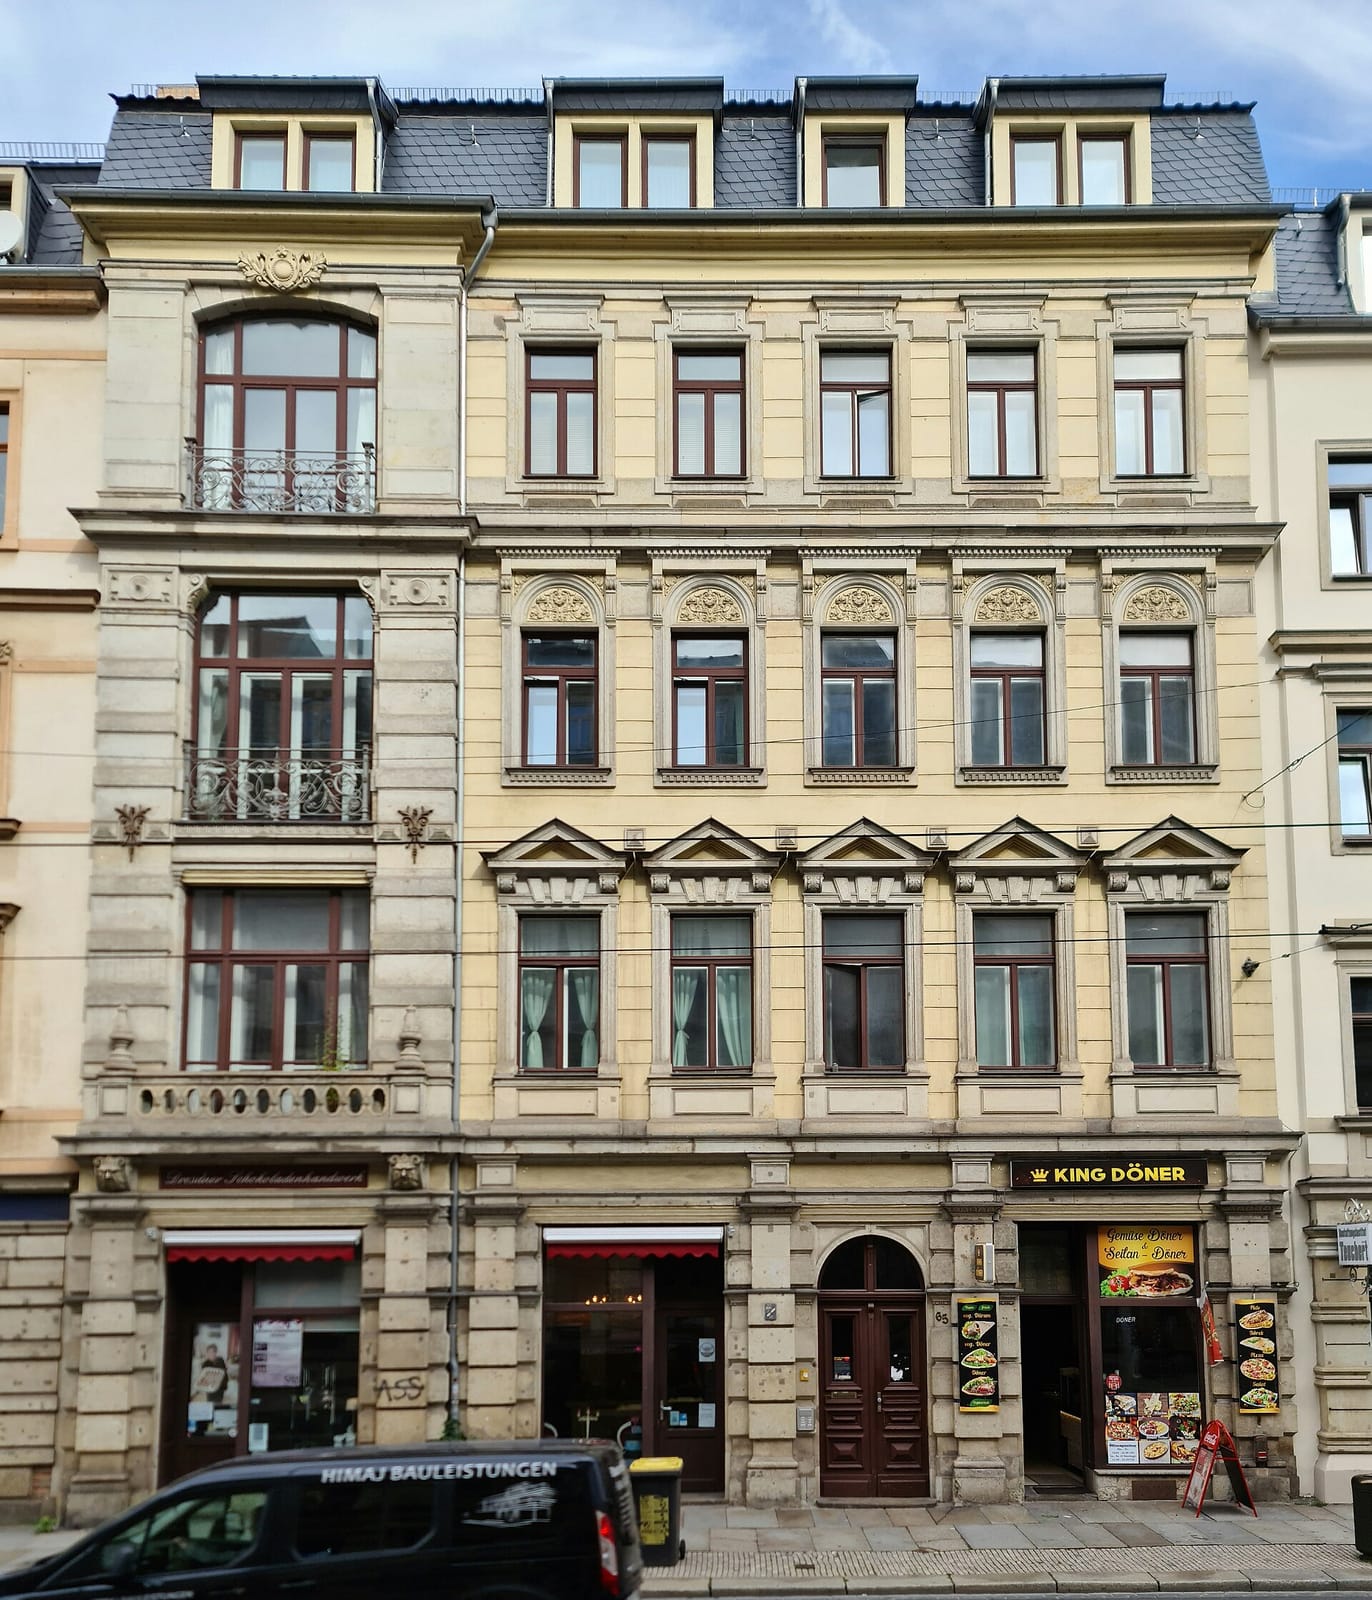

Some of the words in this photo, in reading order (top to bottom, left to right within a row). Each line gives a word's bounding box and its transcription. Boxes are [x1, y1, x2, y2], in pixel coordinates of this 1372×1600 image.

[1054, 1168, 1106, 1183] KING
[1112, 1163, 1185, 1182] DÖNER
[1106, 1228, 1145, 1243] Gemüse
[1147, 1228, 1183, 1242] Döner
[1141, 1242, 1148, 1250] &
[1151, 1246, 1188, 1260] Döner
[935, 1311, 949, 1325] 65
[320, 1468, 387, 1484] HIMAJ
[389, 1461, 558, 1482] BAULEISTUNGEN
